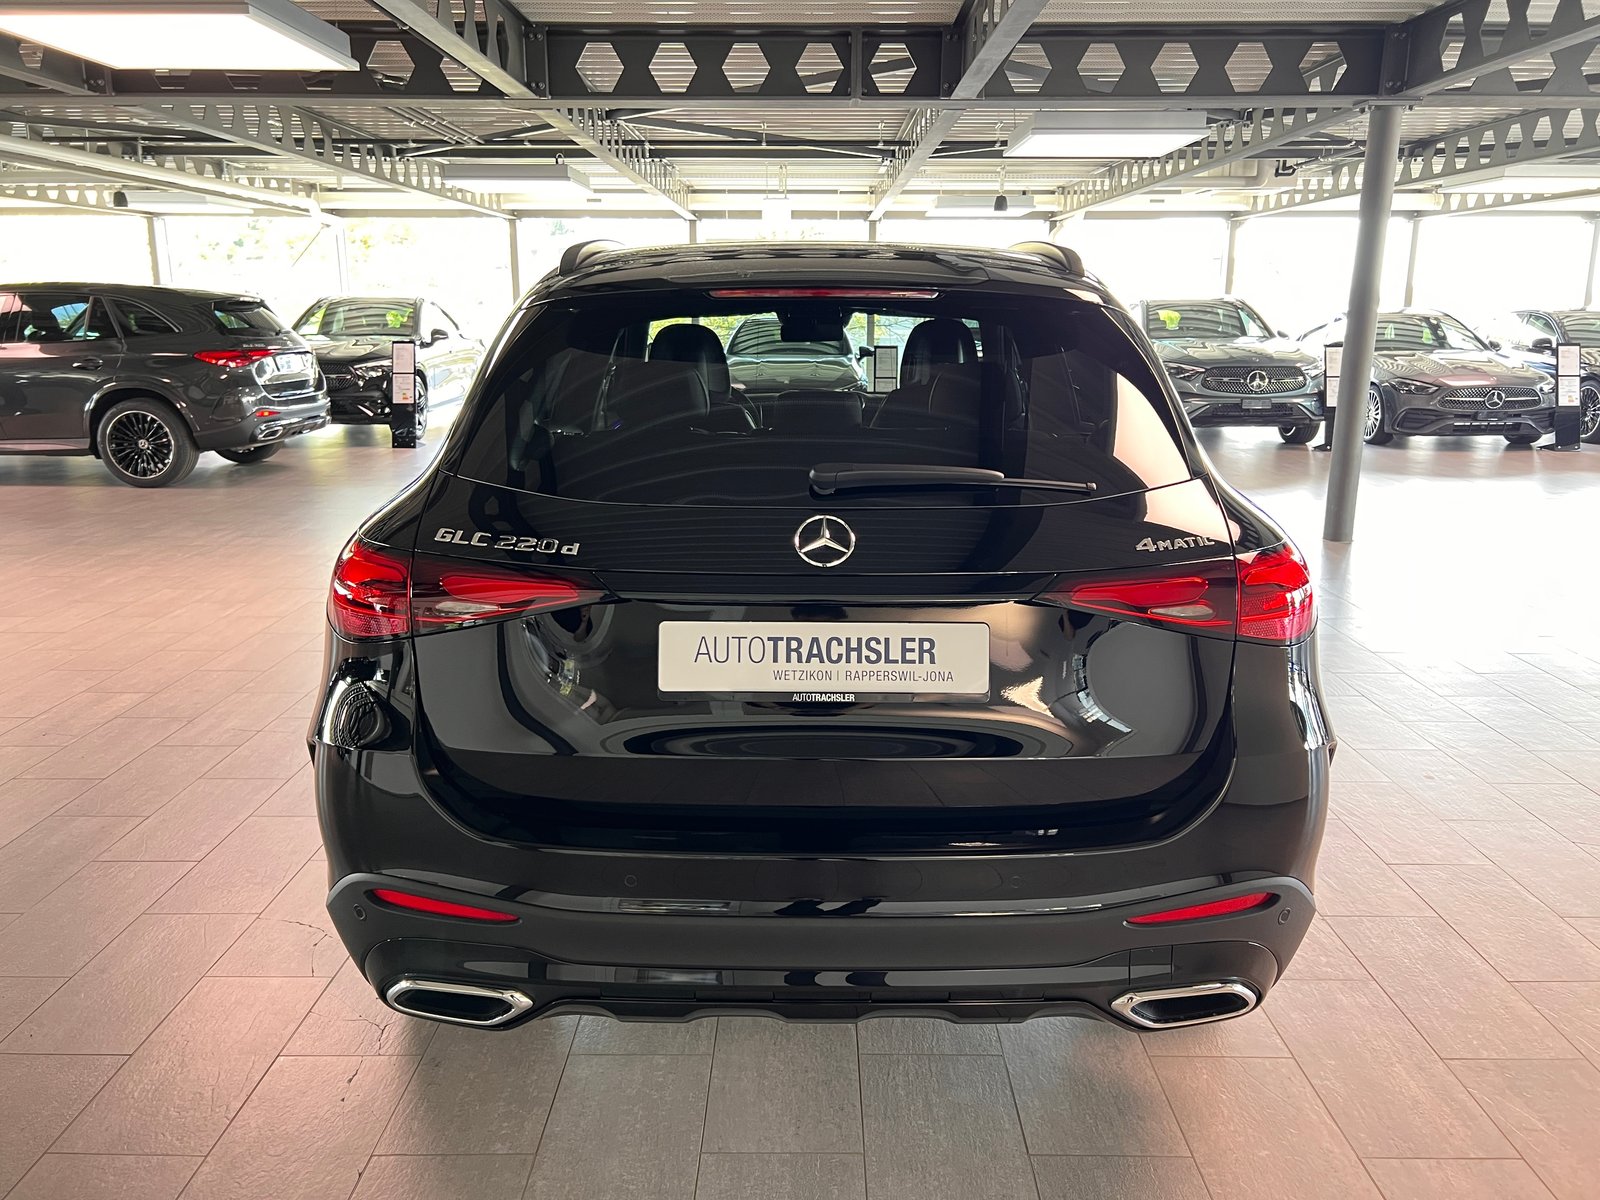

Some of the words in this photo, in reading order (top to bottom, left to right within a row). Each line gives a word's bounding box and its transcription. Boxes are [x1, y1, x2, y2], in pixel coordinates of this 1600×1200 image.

[434, 527, 491, 547] GLC
[1135, 536, 1215, 552] 4MATIC
[694, 635, 937, 665] AUTOTRACHSLER
[772, 669, 833, 682] WETZIKON
[845, 669, 955, 682] RAPPERSWIL-JONA
[792, 693, 855, 702] AUTOTRACHSLER
